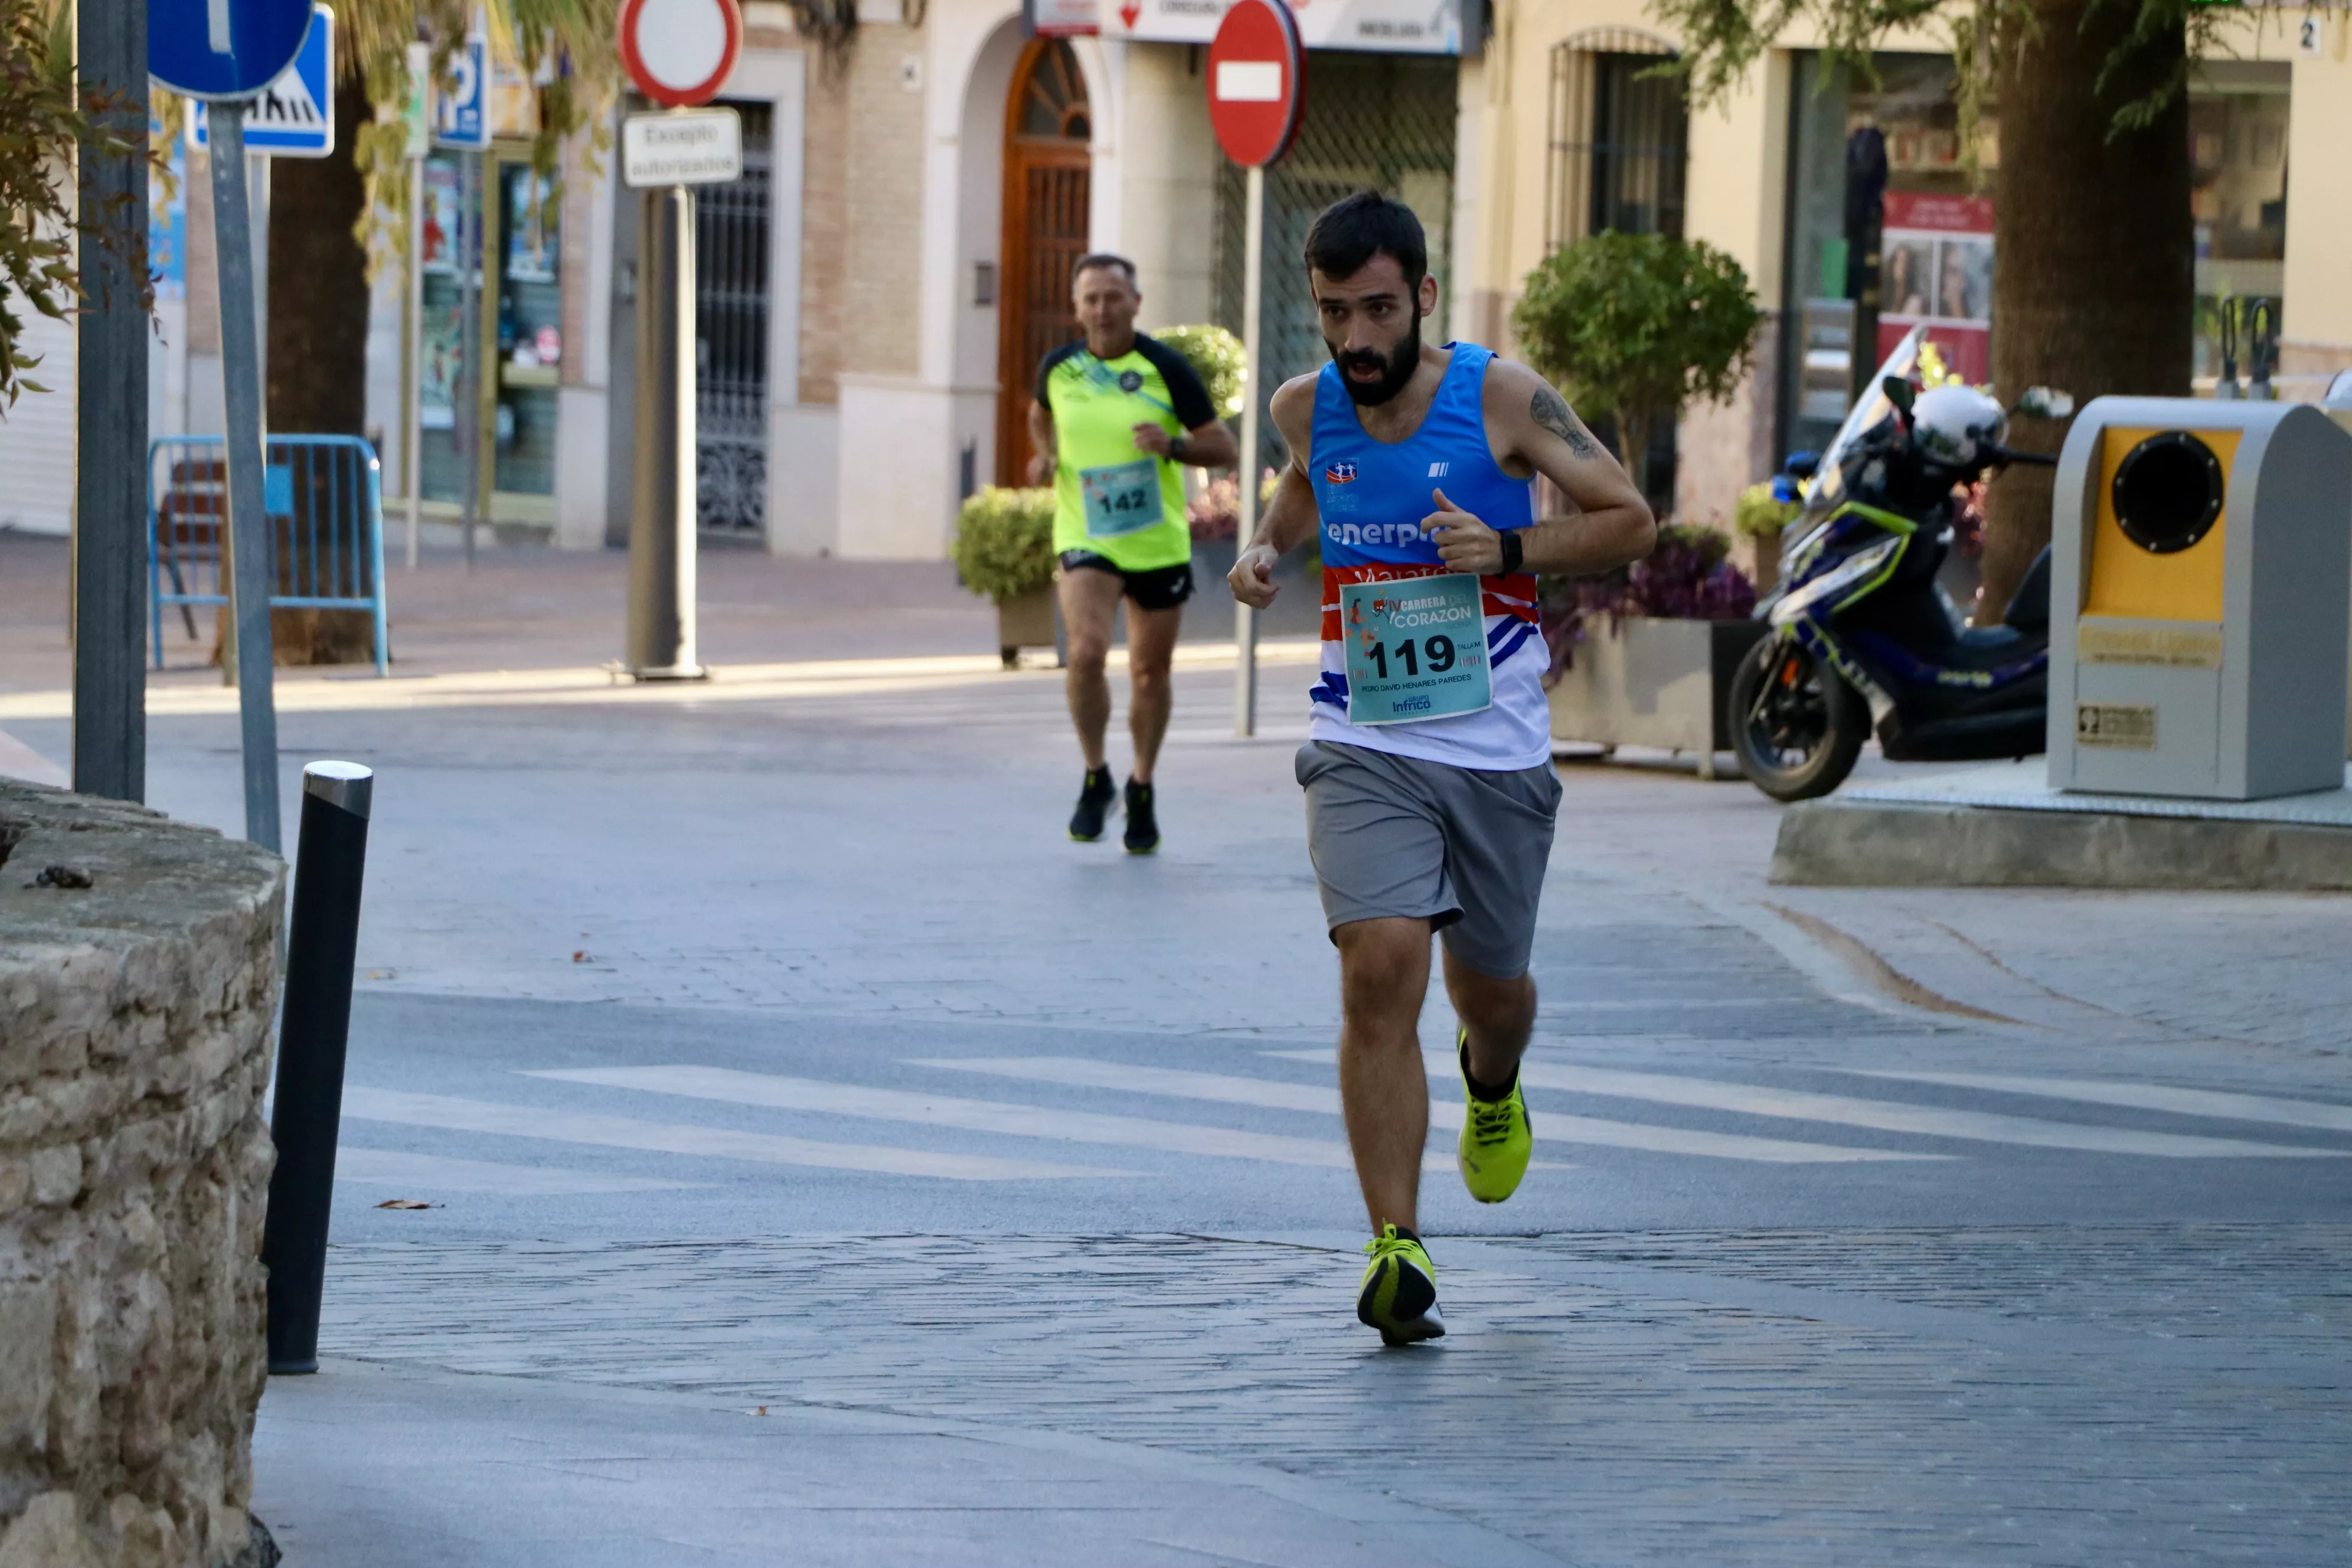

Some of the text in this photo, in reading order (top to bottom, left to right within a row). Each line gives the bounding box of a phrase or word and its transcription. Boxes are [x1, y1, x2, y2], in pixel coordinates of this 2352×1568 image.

[2301, 22, 2314, 48] 2
[645, 124, 718, 146] Excepto
[632, 156, 734, 176] autorizados
[1098, 489, 1148, 514] 142
[1389, 593, 1469, 612] IV CARRERA DEL
[1369, 635, 1455, 679] 119
[1402, 679, 1436, 690] HENARES
[1438, 674, 1472, 685] PAREDES
[1392, 699, 1431, 713] Infrico
[1408, 694, 1429, 703] GRUPO
